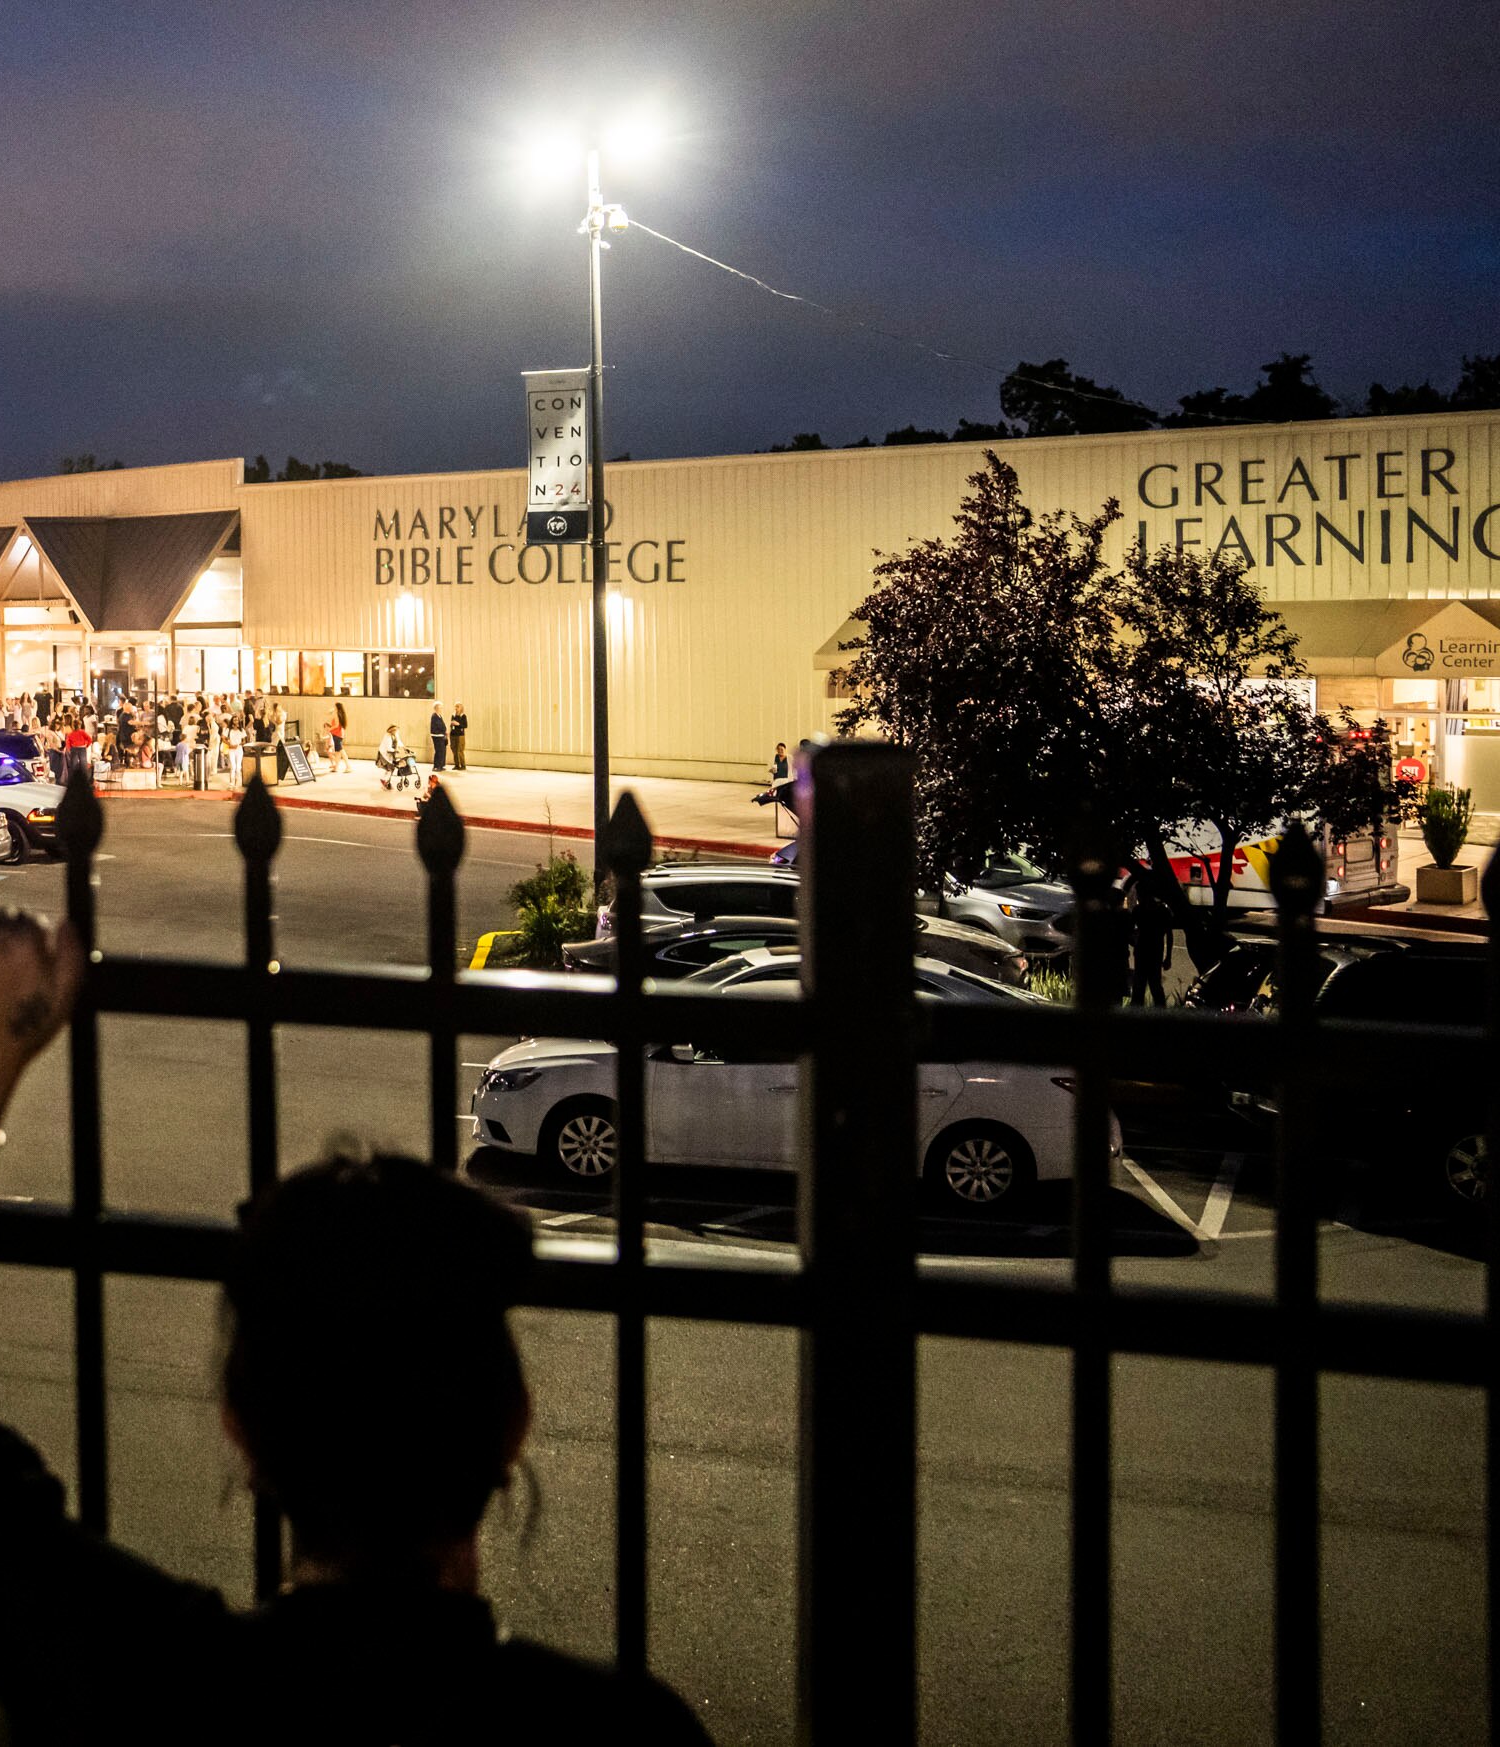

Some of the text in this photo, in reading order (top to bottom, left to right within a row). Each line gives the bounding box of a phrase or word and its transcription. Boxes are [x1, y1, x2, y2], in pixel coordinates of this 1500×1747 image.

[535, 397, 581, 412] CON
[536, 426, 581, 439] VEN
[536, 454, 582, 468] TIO
[1137, 448, 1460, 510] GREATER
[375, 546, 474, 586] BIBLE
[1443, 655, 1494, 668] Center
